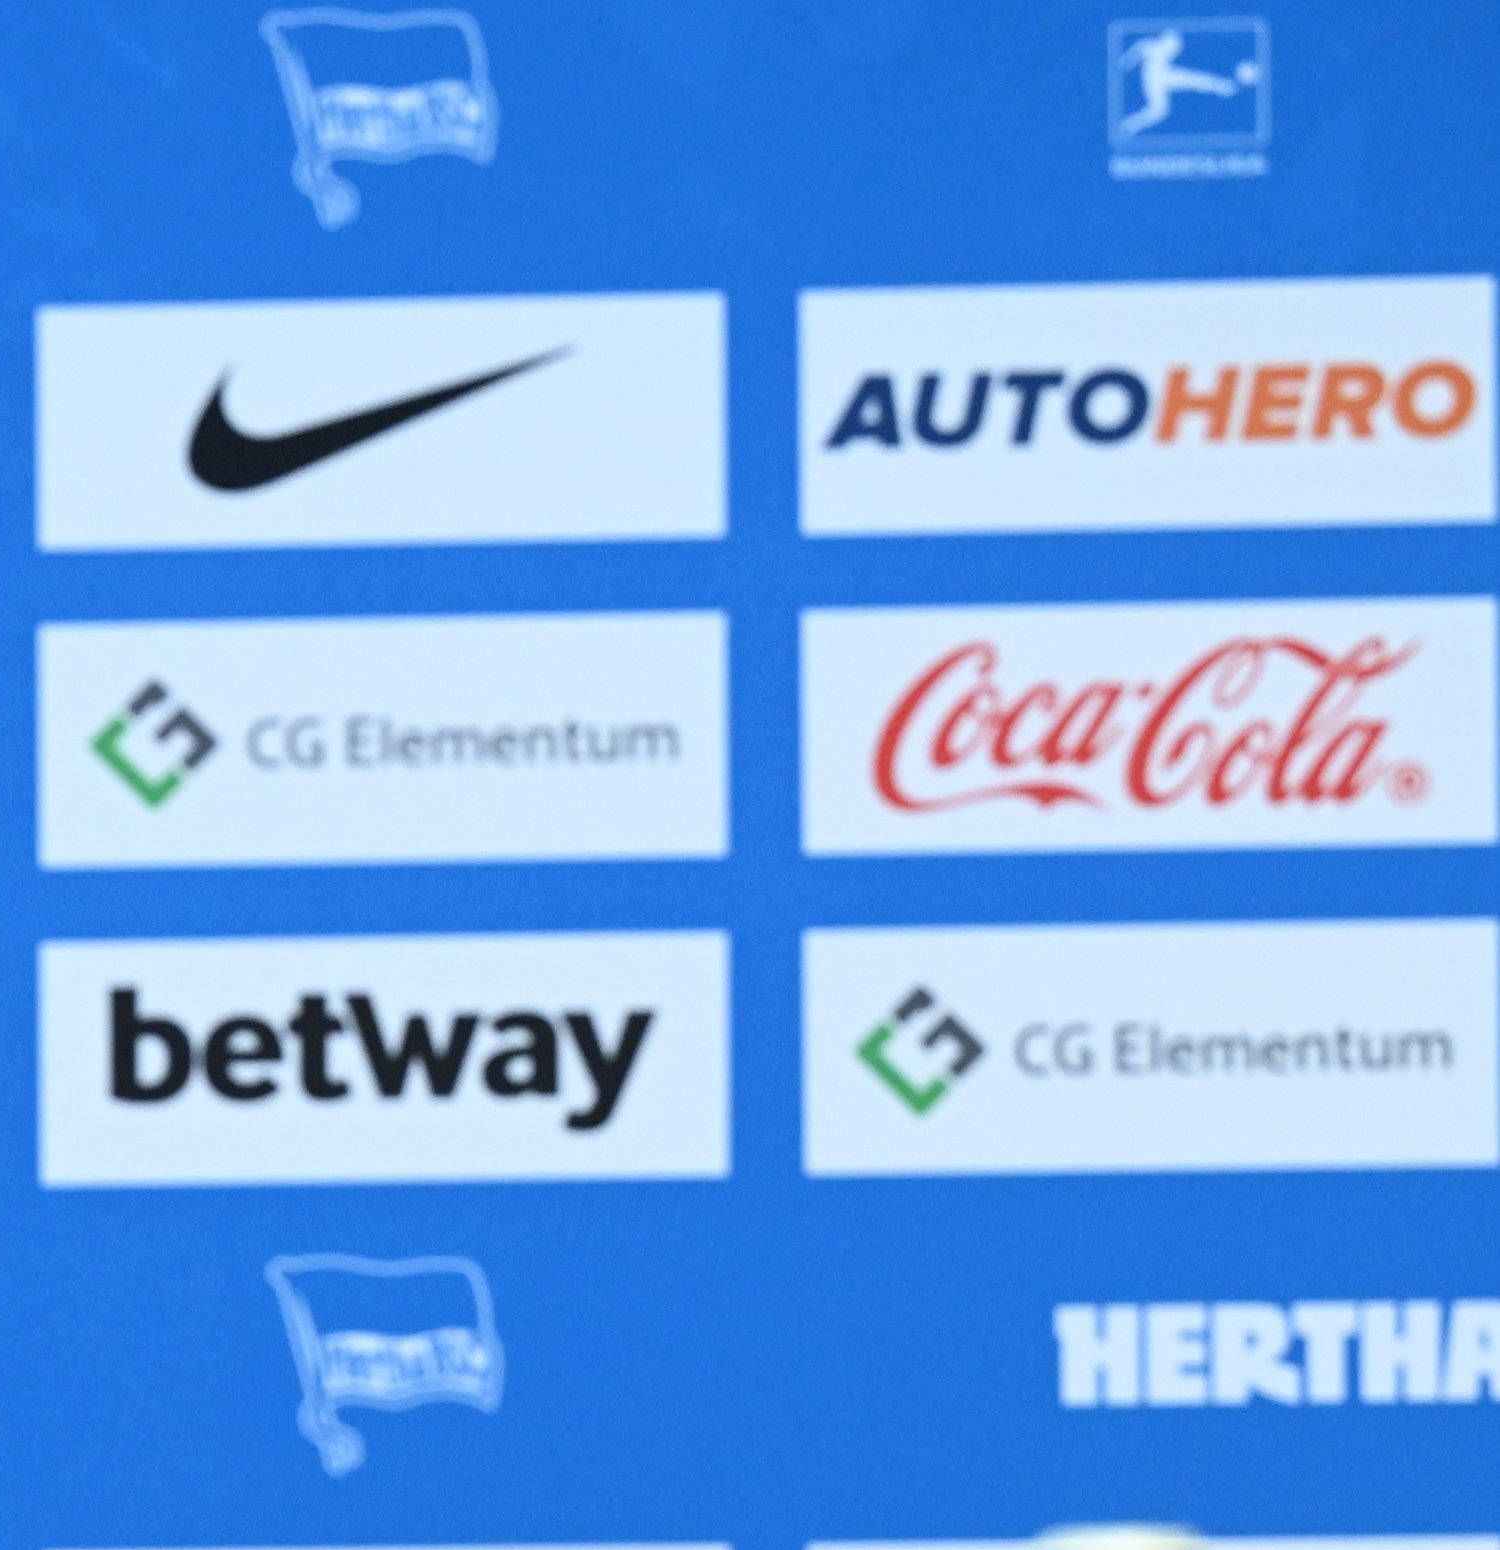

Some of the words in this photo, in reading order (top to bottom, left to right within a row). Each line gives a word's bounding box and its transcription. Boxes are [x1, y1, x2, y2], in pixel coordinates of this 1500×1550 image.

[823, 360, 1477, 452] AUTOHERO
[243, 713, 328, 773] CG
[342, 713, 684, 770] Elementum
[107, 984, 657, 1135] betway
[1011, 1020, 1096, 1080] CG
[1111, 1020, 1457, 1078] Elementum
